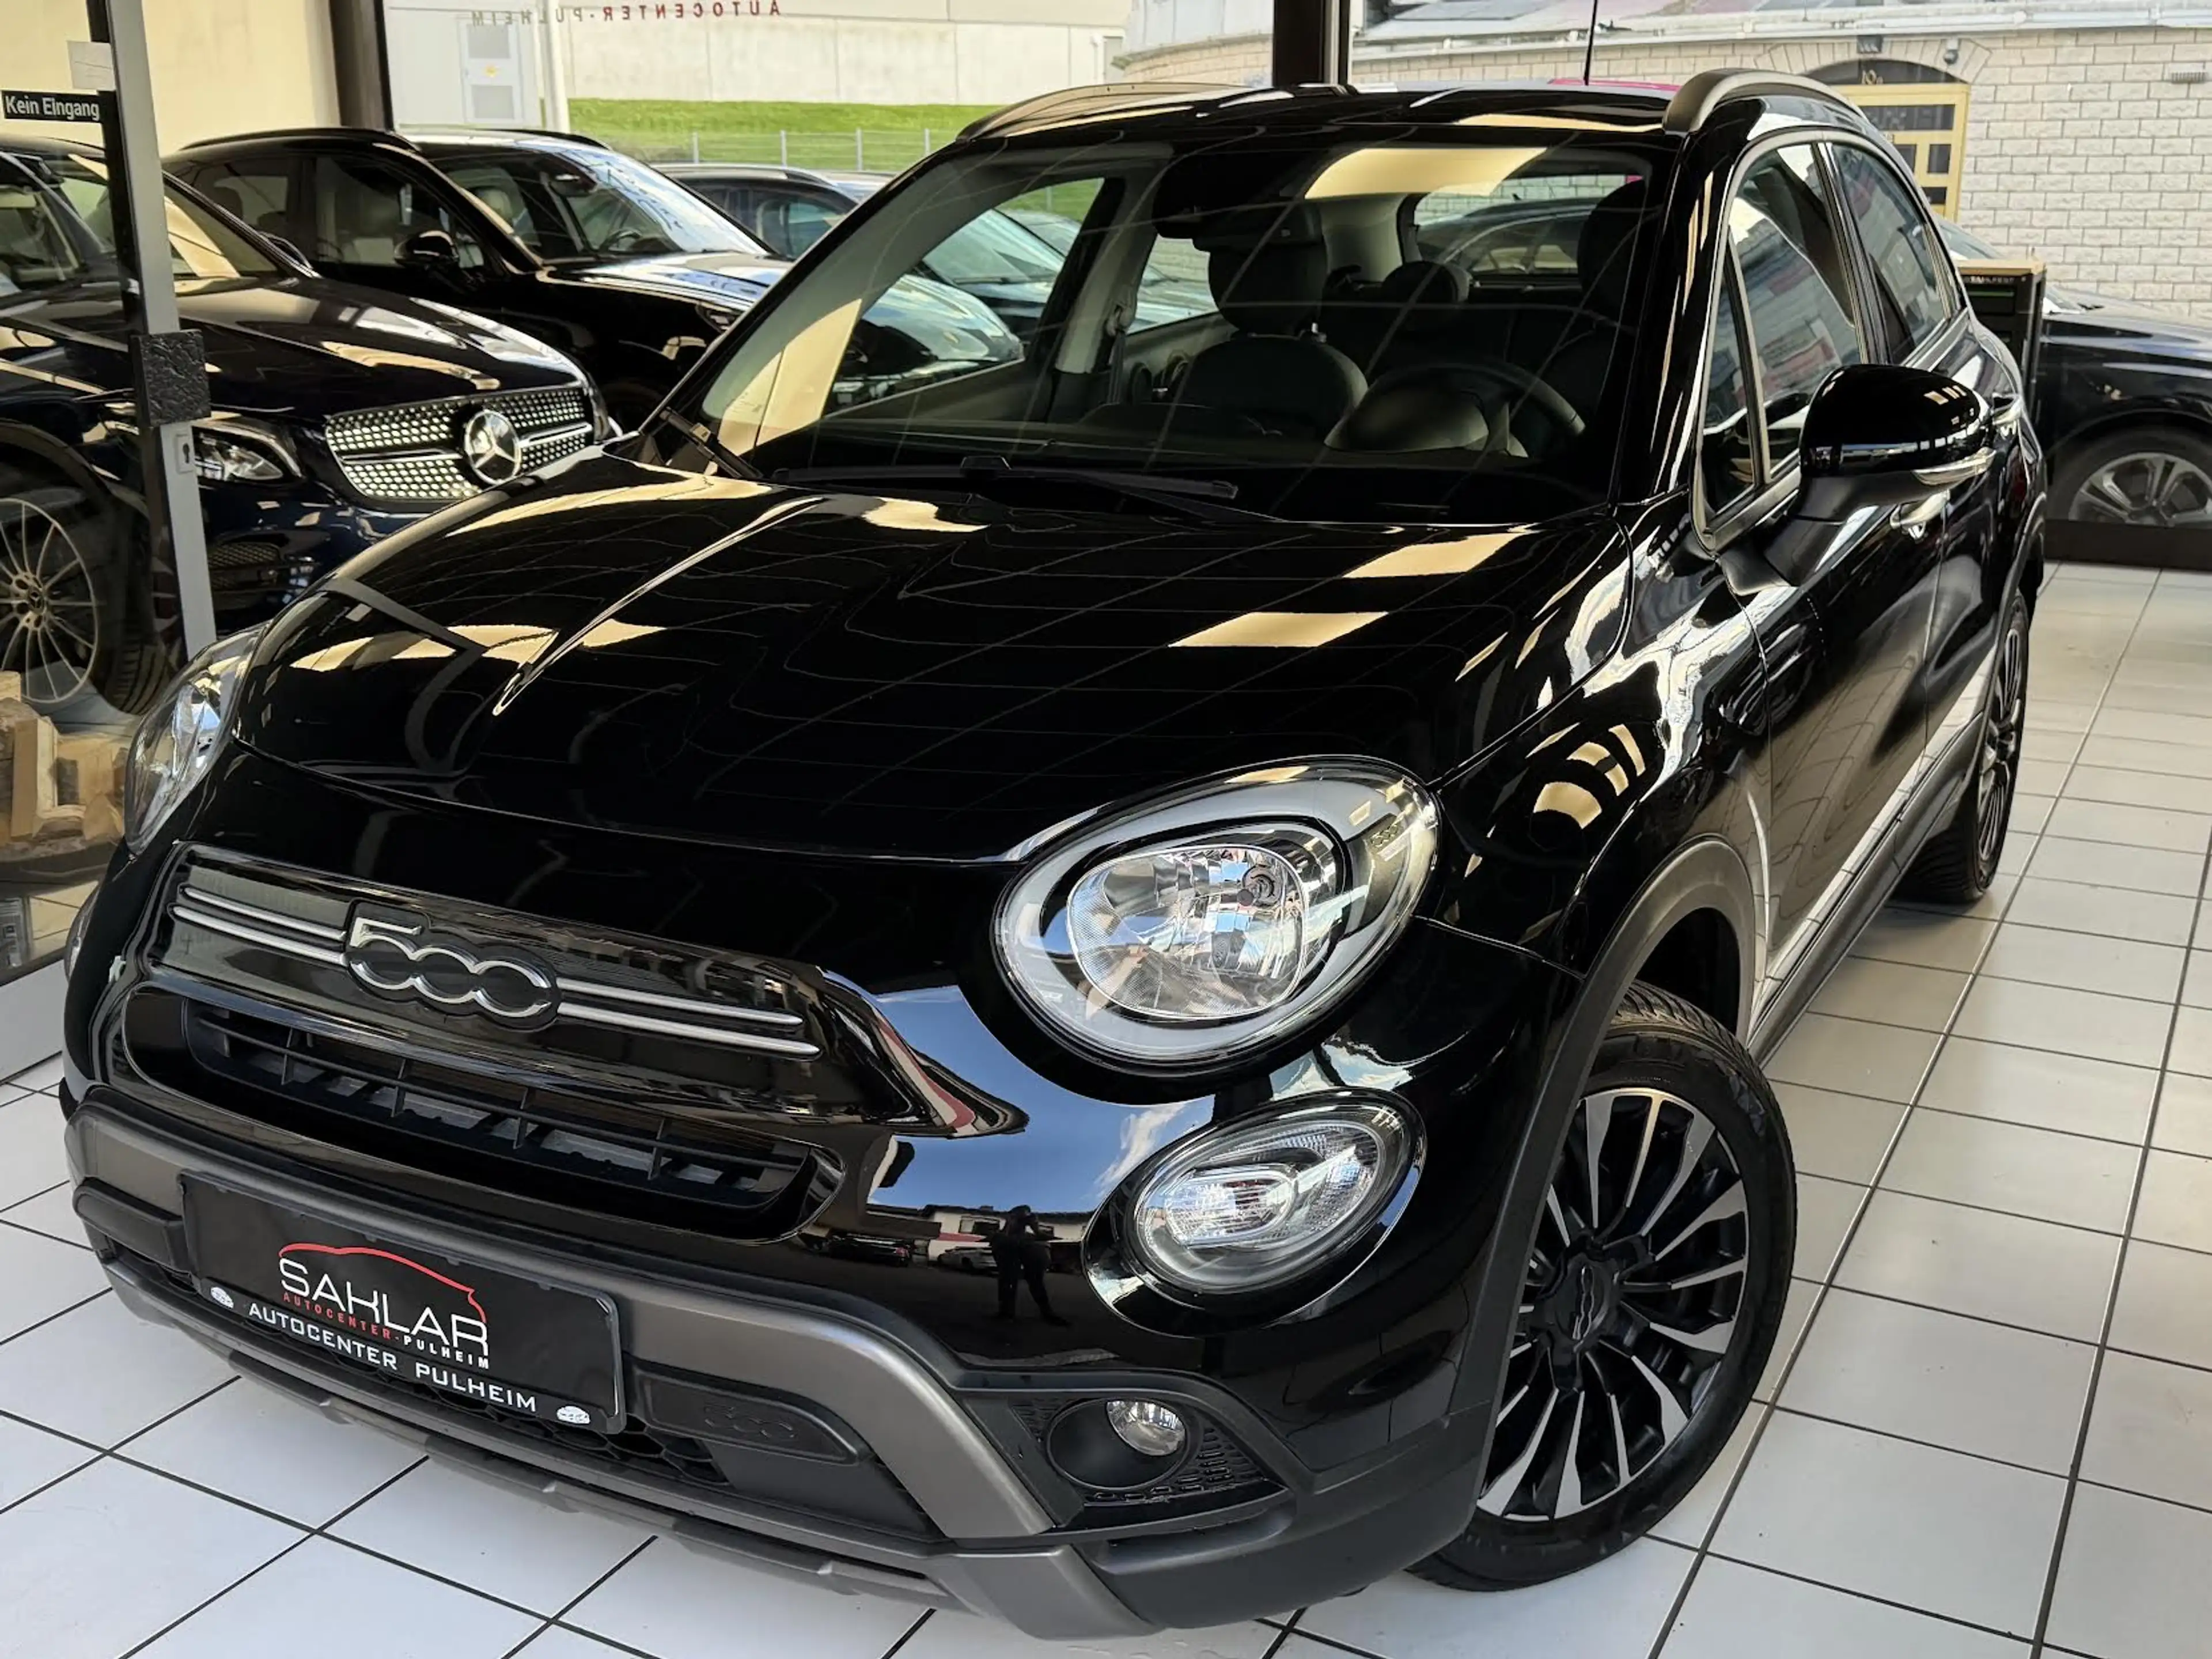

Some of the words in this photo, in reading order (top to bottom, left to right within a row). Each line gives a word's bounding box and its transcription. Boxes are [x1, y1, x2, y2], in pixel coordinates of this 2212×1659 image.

[5, 95, 40, 115] Kein
[42, 97, 100, 121] Eingang
[349, 917, 553, 1018] 500
[279, 1257, 489, 1356] SAHLAR
[248, 1303, 397, 1370] AUTOCENTER
[415, 1361, 536, 1412] PULHEIM
